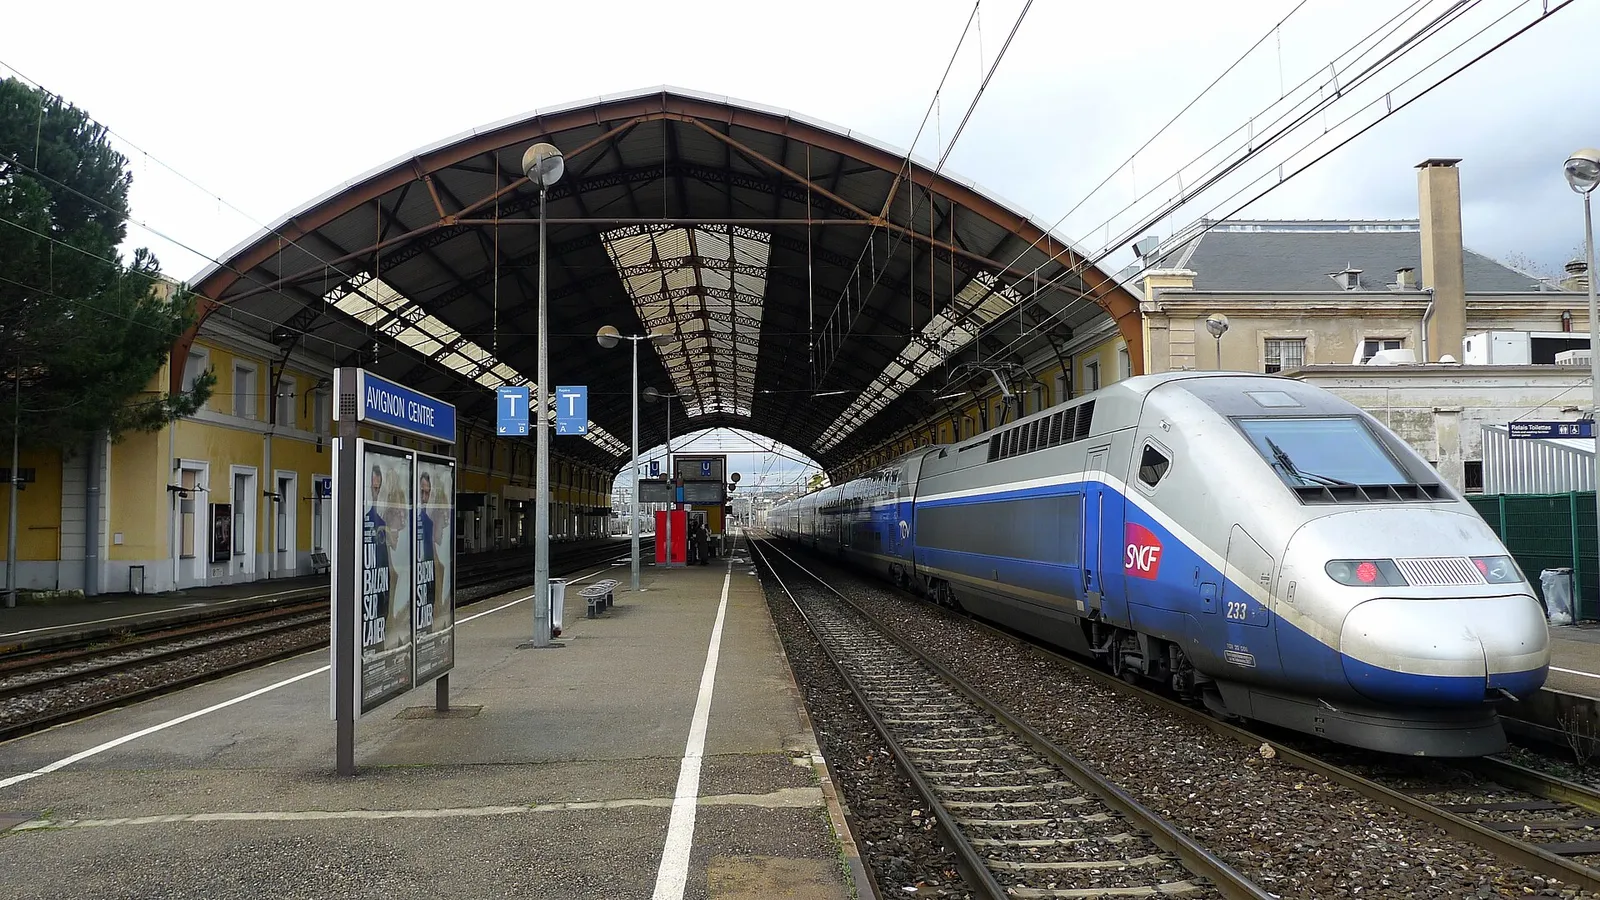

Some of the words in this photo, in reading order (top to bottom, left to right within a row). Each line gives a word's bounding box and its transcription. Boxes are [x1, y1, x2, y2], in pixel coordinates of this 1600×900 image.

[366, 386, 405, 418] AVIGNON
[408, 401, 435, 427] CENTRE
[504, 394, 522, 416] T
[562, 394, 580, 416] T
[702, 462, 710, 470] U
[364, 544, 376, 569] UN
[1125, 544, 1161, 572] SNCF
[364, 594, 378, 622] SUR
[1226, 601, 1247, 620] 233
